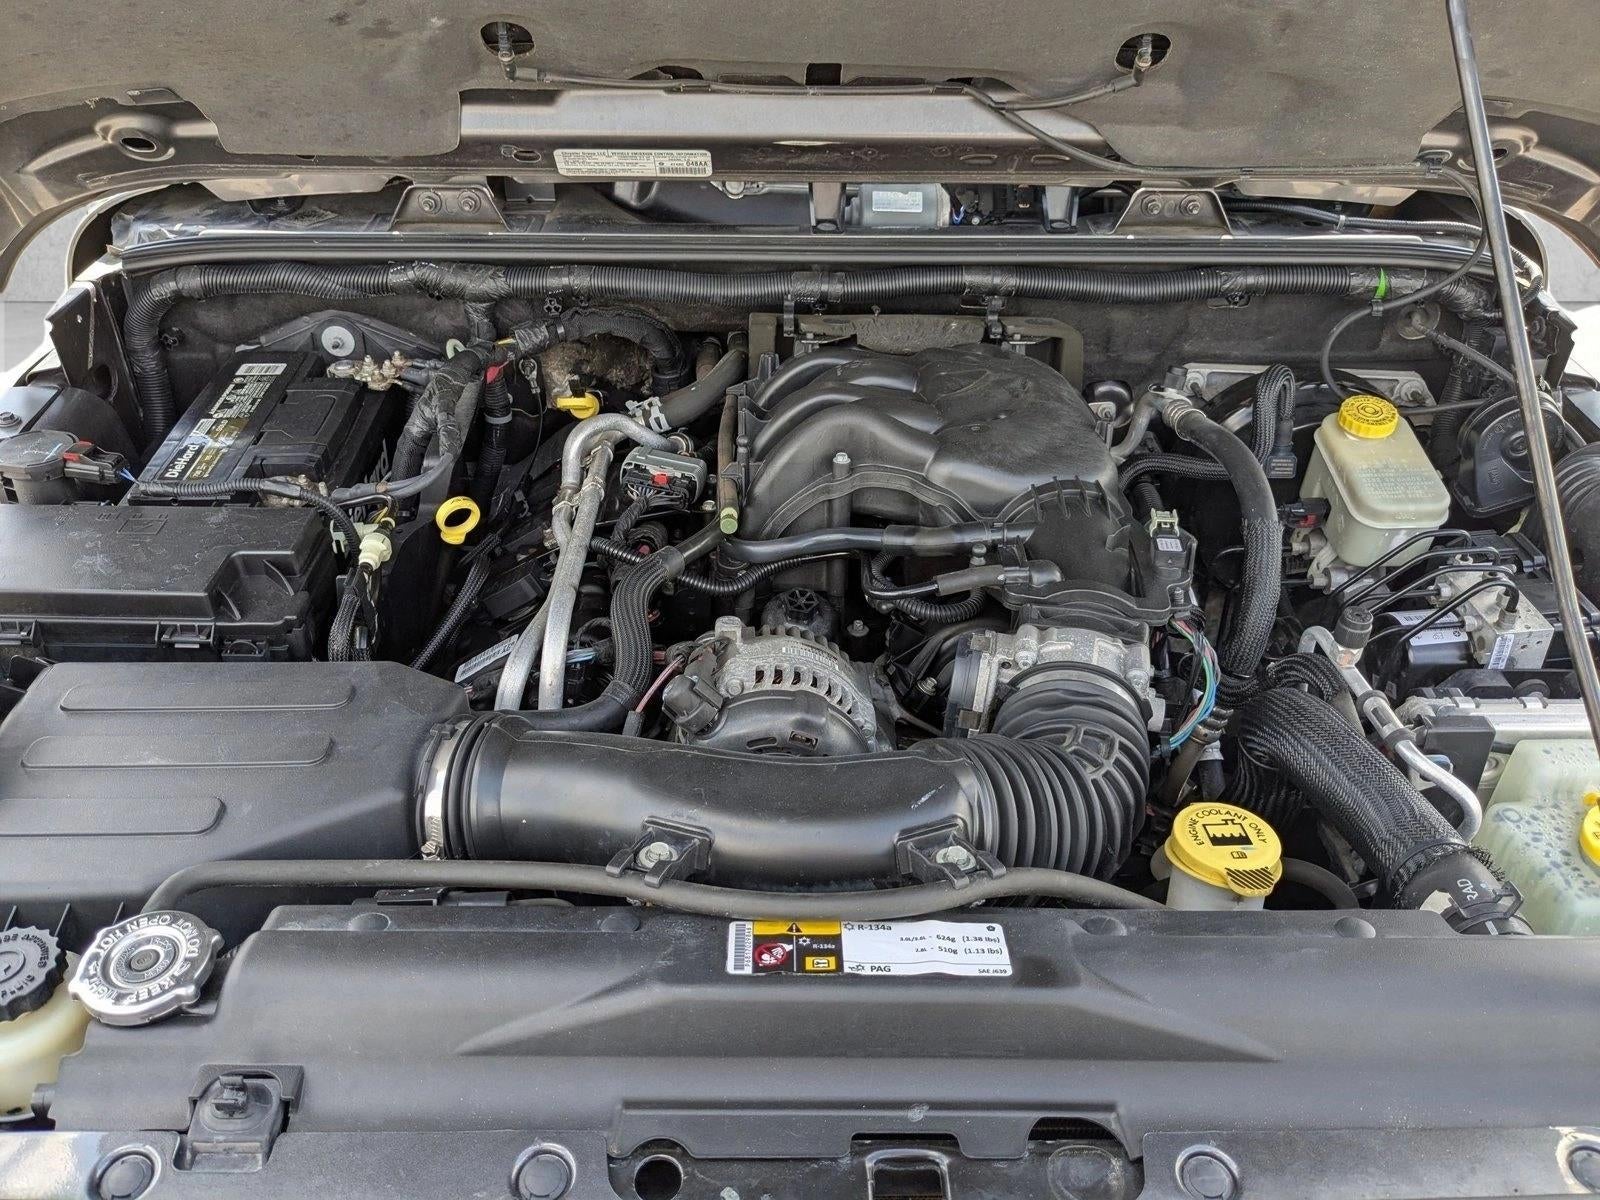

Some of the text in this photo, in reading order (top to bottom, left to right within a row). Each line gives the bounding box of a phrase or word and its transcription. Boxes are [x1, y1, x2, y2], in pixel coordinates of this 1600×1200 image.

[165, 444, 200, 478] DieHard
[1188, 808, 1268, 846] ENGINE COOLANT ONLY
[125, 914, 171, 933] OPEN
[172, 918, 199, 939] NOT
[97, 931, 123, 957] HOT
[186, 938, 201, 958] DO
[936, 934, 956, 943] 624g
[962, 935, 983, 944] (1.38
[984, 936, 1001, 944] lbs)
[938, 945, 958, 955] 510g
[987, 947, 1003, 955] lbs)
[870, 965, 892, 973] PAG
[85, 976, 176, 1003] KEEP TIGHT
